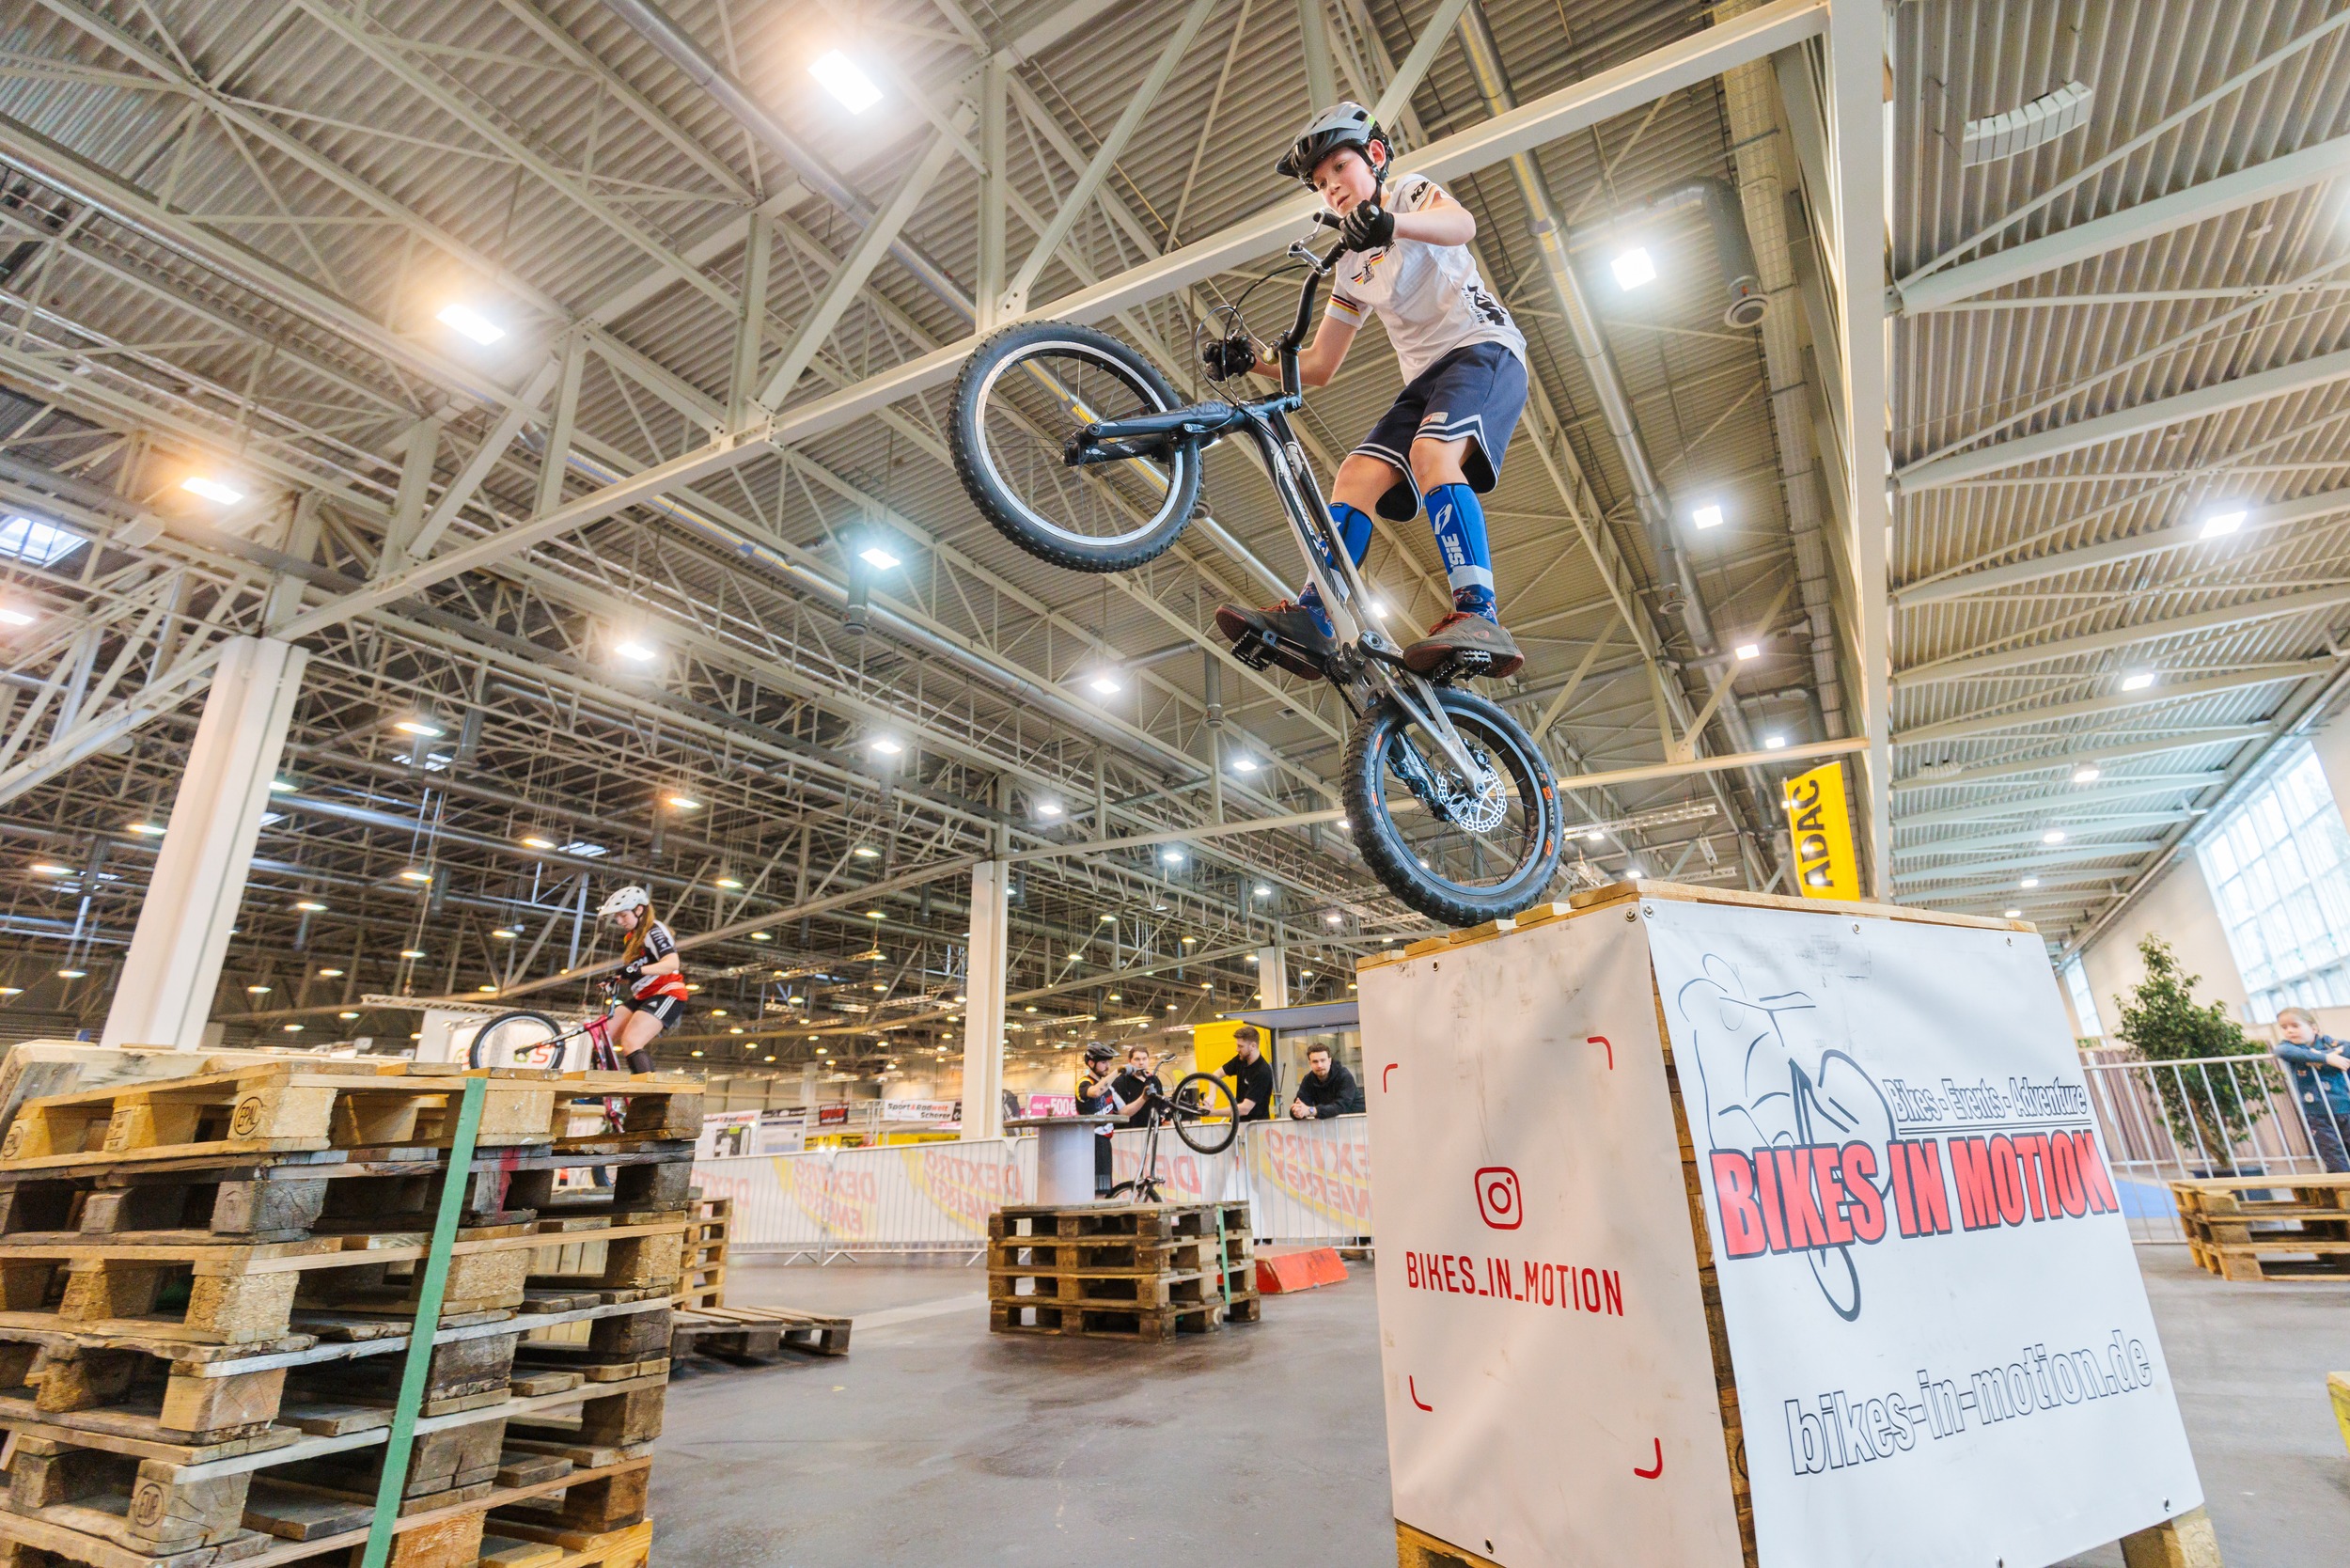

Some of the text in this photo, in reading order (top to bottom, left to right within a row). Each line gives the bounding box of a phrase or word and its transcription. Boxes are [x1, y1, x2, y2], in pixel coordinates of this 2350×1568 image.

[1792, 779, 1834, 887] ADAC
[237, 1105, 260, 1129] EPAL
[1883, 1078, 1938, 1122] Bikes
[1941, 1076, 2002, 1121] Events
[2009, 1075, 2088, 1118] Adventure
[1708, 1128, 2121, 1260] BIKES IN MOTION
[1405, 1250, 1624, 1317] BIKES_IN_MOTION
[1784, 1328, 2154, 1477] bikes-in-motion.de
